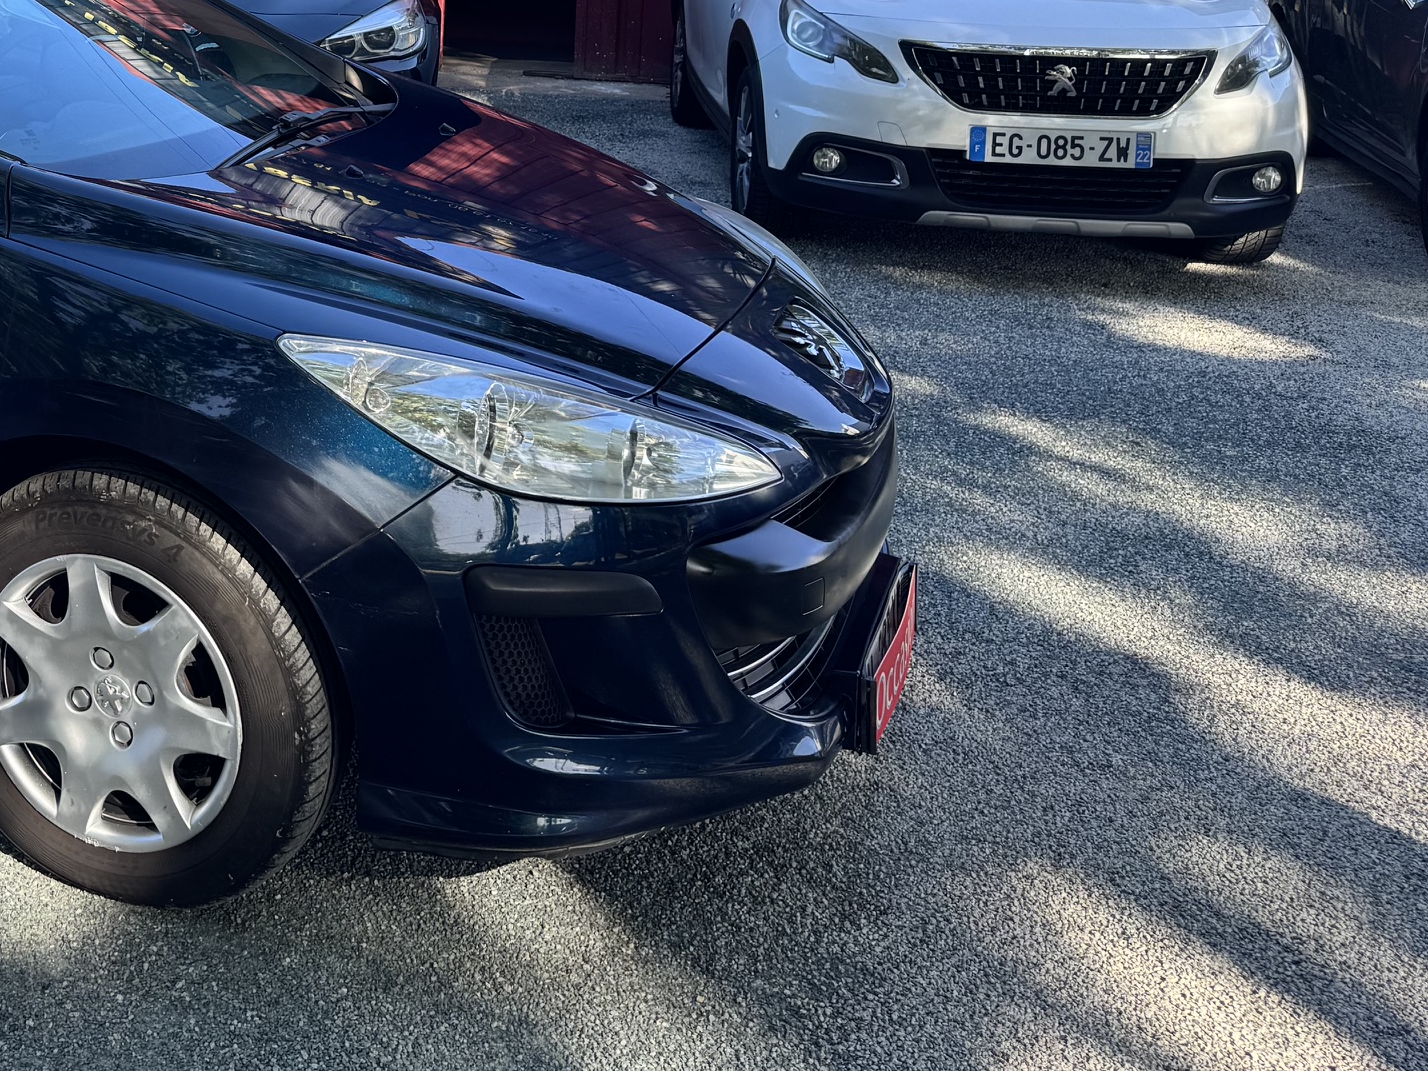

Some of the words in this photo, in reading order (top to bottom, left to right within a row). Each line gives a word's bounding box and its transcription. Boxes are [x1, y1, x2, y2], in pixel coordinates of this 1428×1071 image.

[991, 132, 1131, 163] EG-085-ZW
[1136, 150, 1151, 163] 22
[160, 543, 185, 563] 4
